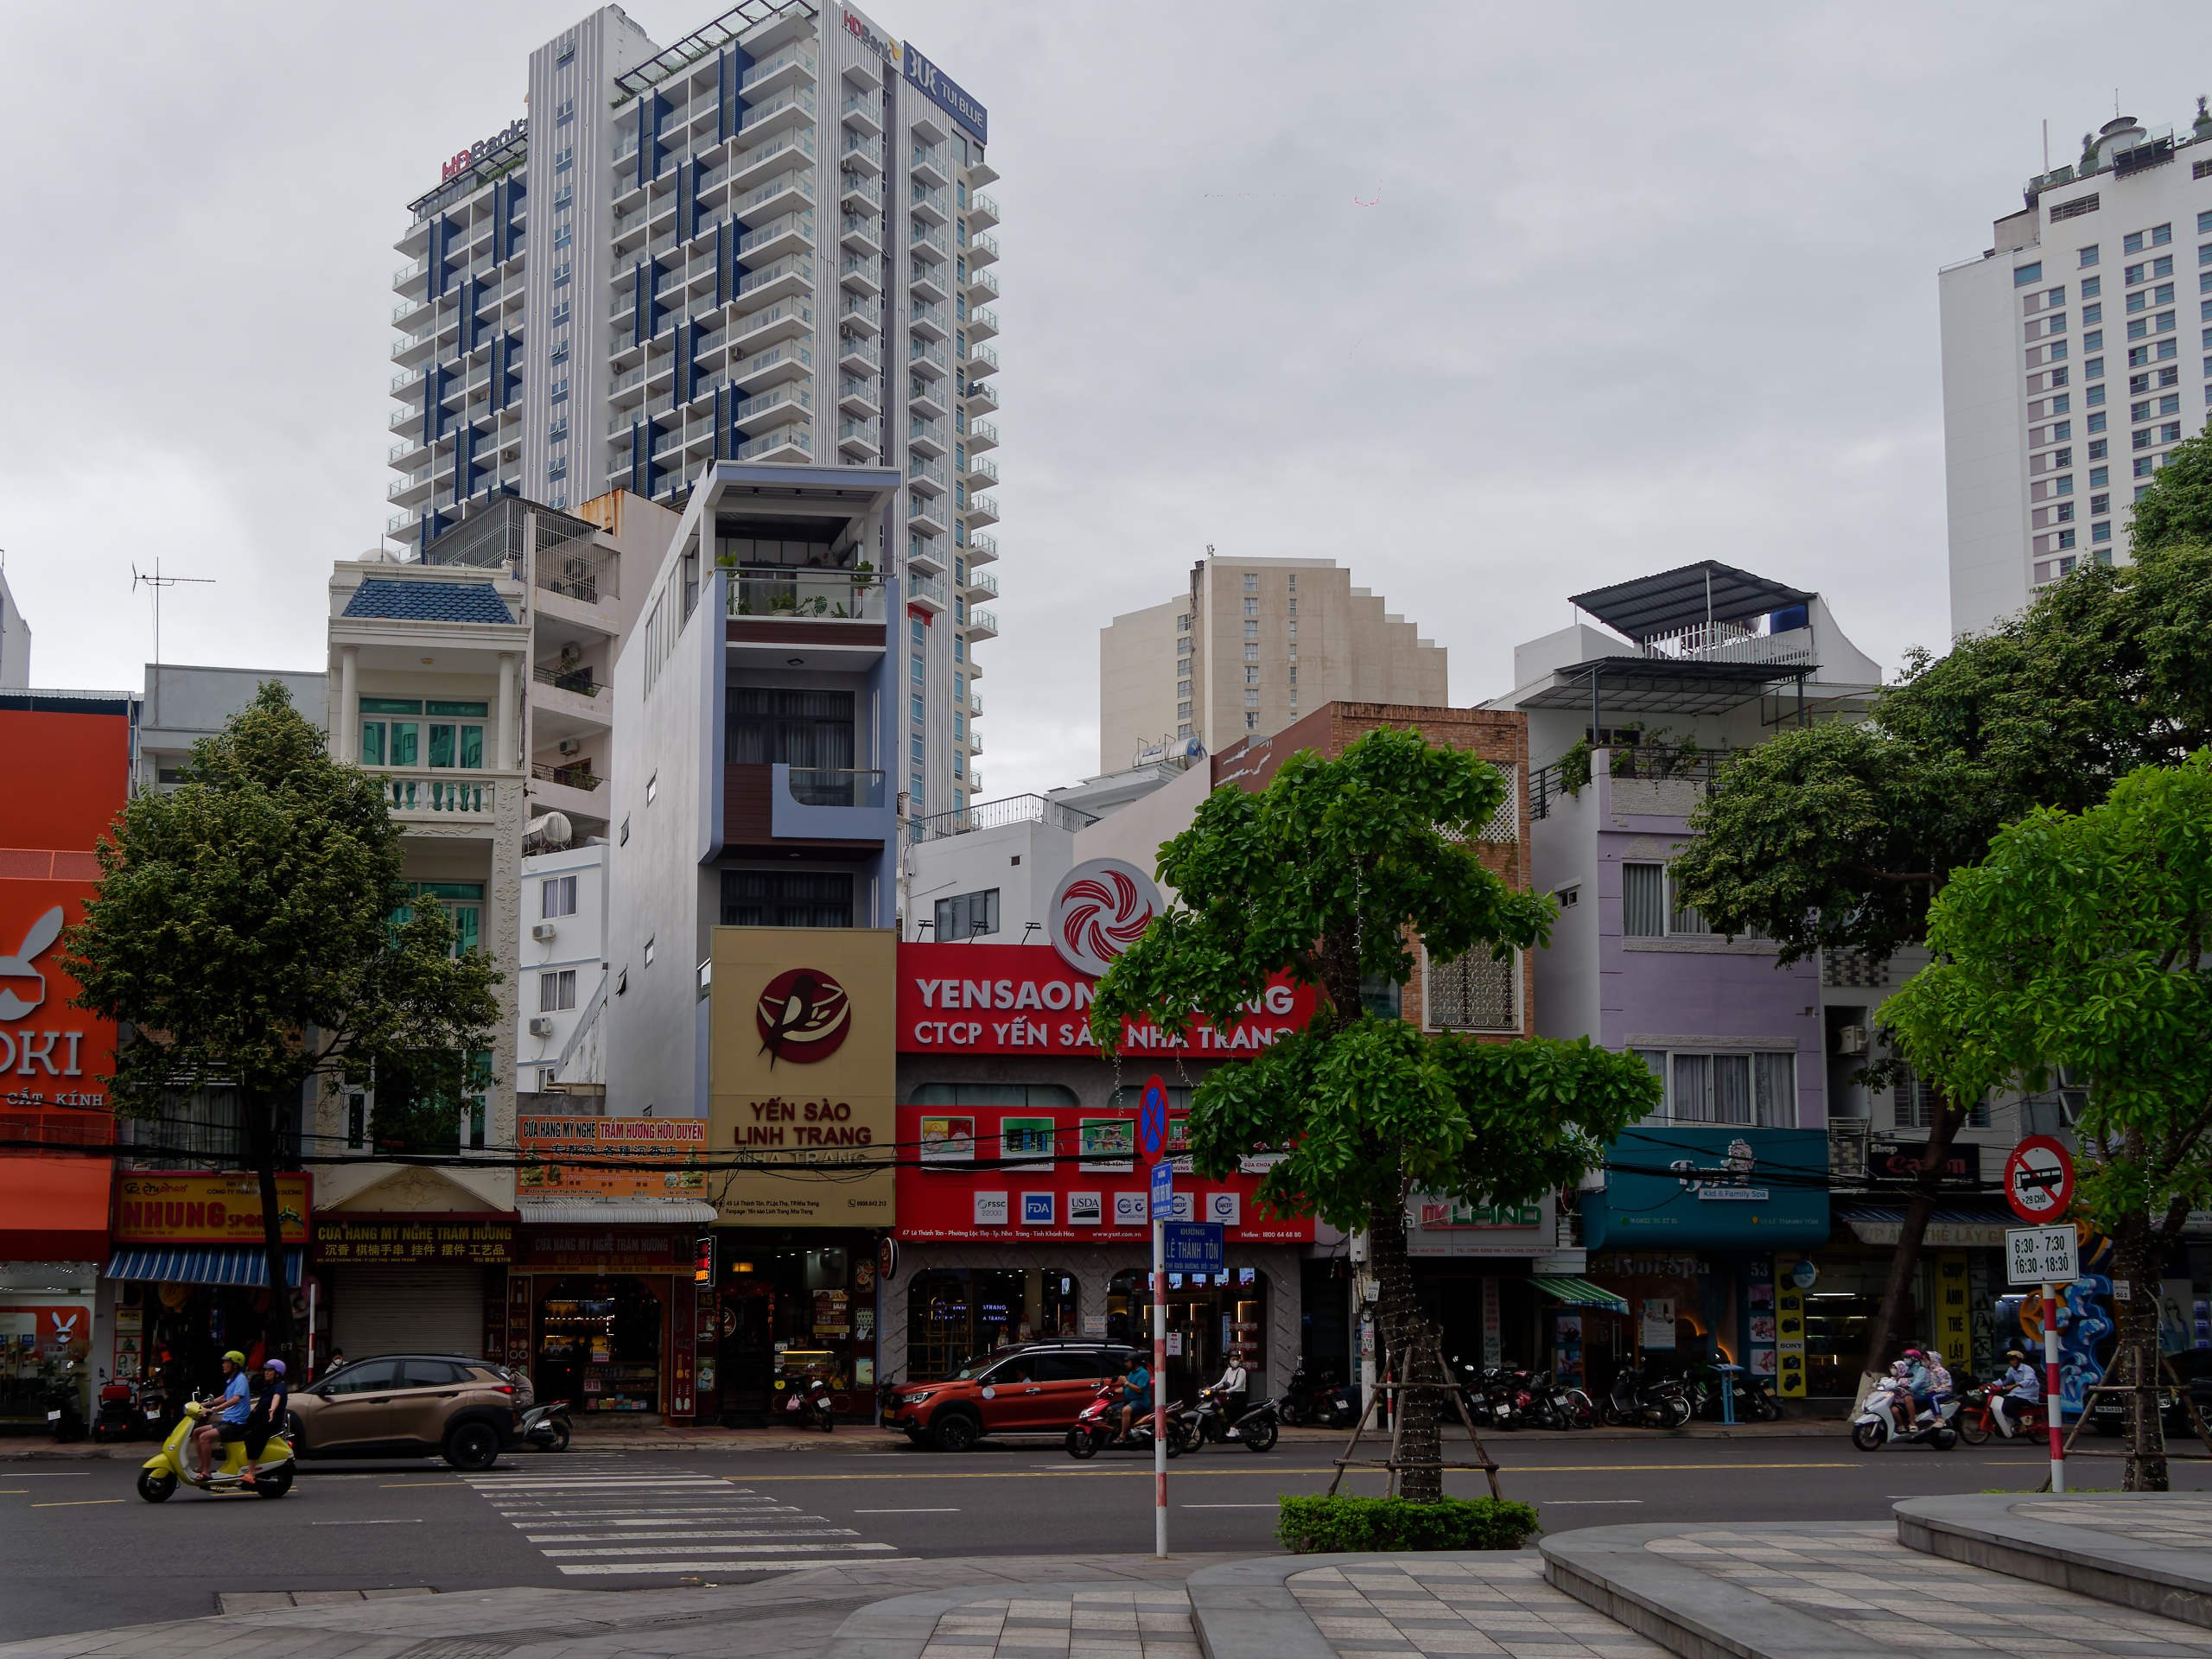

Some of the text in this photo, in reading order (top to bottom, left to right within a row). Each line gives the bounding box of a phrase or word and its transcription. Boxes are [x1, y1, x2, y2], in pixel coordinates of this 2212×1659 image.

[844, 10, 892, 63] HDBank
[941, 81, 983, 129] TUI BLUE
[914, 1020, 982, 1045] CTCP
[992, 1014, 1047, 1047] YẾN
[1058, 1017, 1108, 1047] SÀ
[7, 1087, 104, 1106] CẮT KÍNH
[750, 1096, 851, 1122] YẾN SÀO
[524, 1116, 704, 1141] CỬA HÀNG MỸ NGHỆ TRẦM HƯƠNG HỮU DUYÊN
[734, 1126, 872, 1145] LINH TRANG
[1871, 1143, 1898, 1154] Shop
[1071, 1198, 1099, 1208] USDA
[1751, 1191, 1767, 1199] Spa
[124, 1201, 226, 1228] NHUNG
[1027, 1203, 1050, 1213] FDA
[318, 1223, 512, 1243] CỬA HÀNG MỸ NGHỆ TRẦM HƯƠNG
[1987, 1224, 2006, 1243] GẤ
[1166, 1237, 1218, 1260] LÊ THÁNH TÔN
[2015, 1237, 2033, 1254] 6:30
[2045, 1236, 2064, 1251] 7:30
[1750, 1261, 1770, 1277] 53
[2015, 1257, 2037, 1274] 16:30
[2045, 1255, 2069, 1272] 18:30
